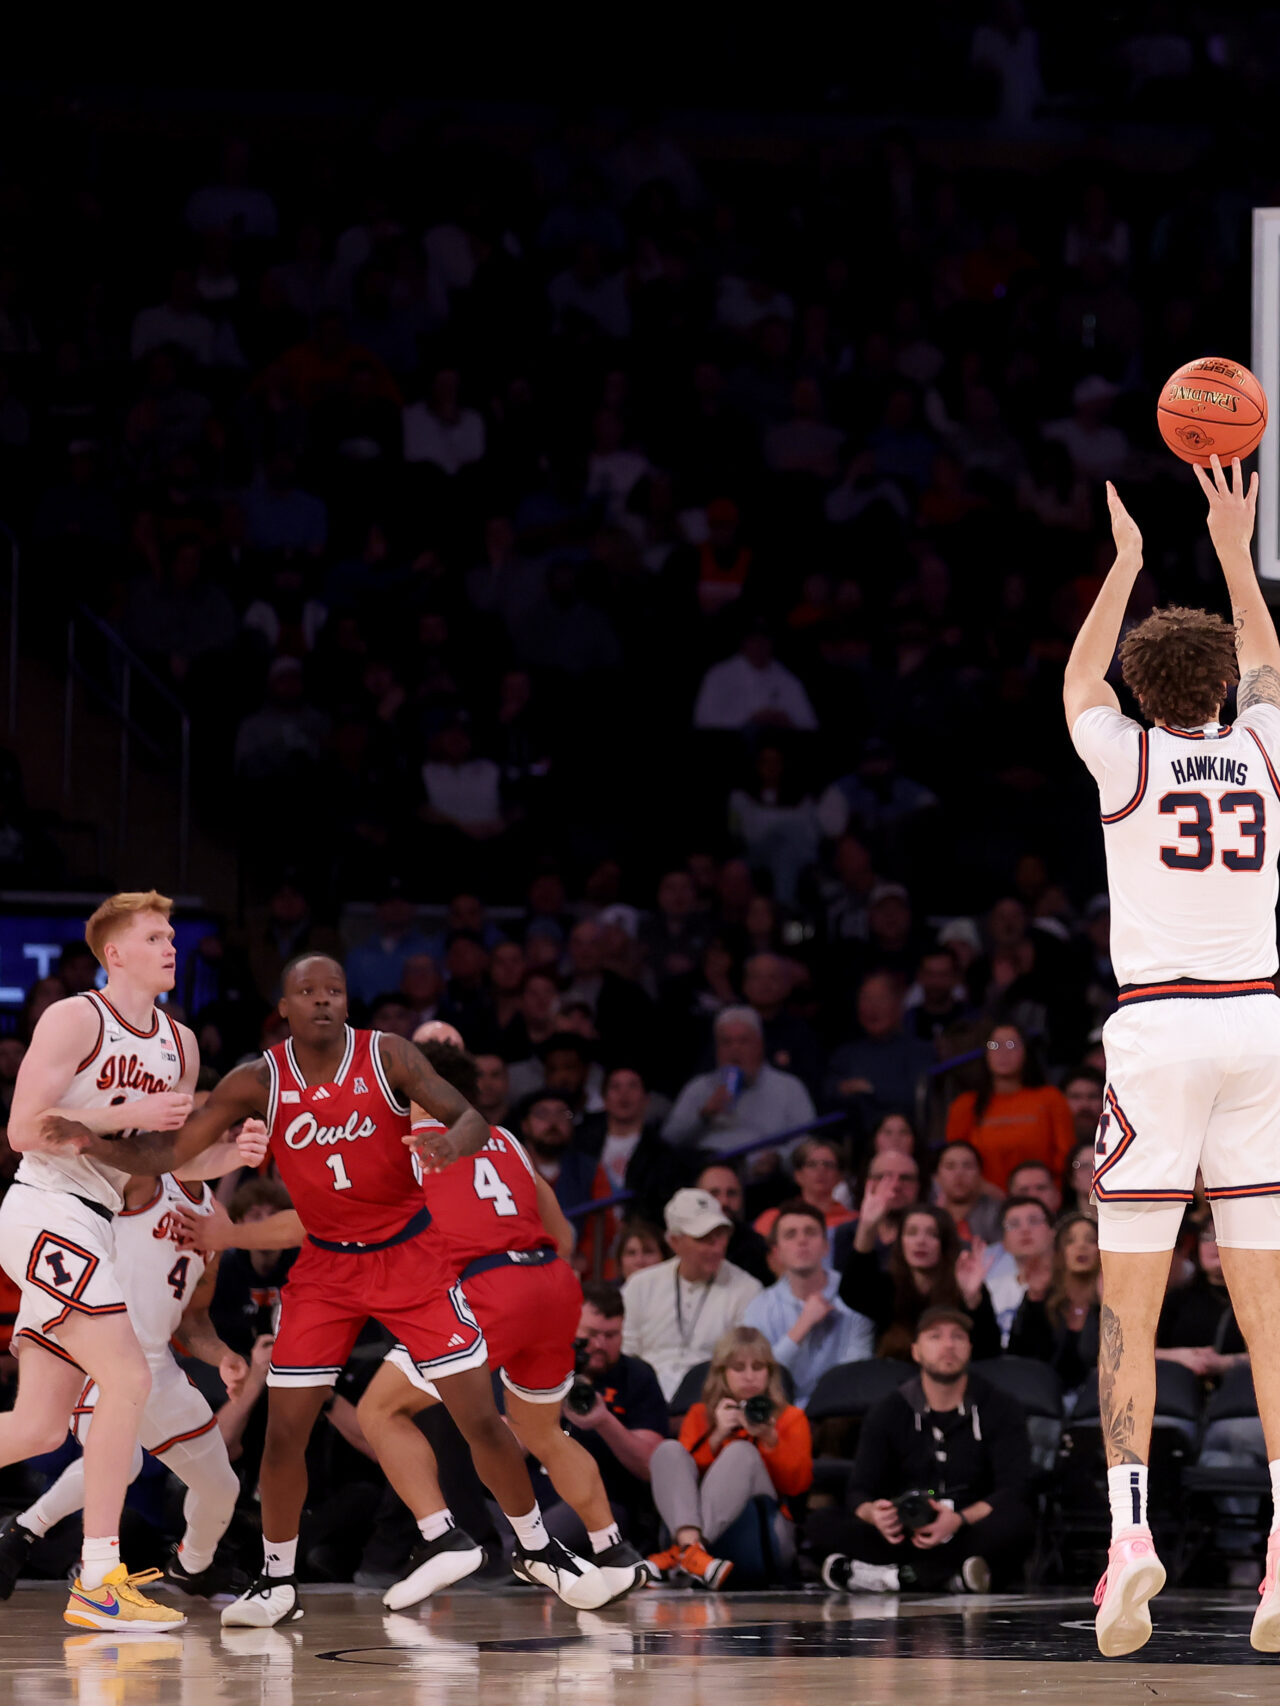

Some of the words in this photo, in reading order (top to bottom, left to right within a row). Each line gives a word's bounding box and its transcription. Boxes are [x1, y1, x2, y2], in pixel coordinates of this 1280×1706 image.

[1169, 384, 1241, 413] SPALDING
[1171, 756, 1248, 786] HAWKINS
[1158, 790, 1266, 872] 33
[96, 1054, 172, 1094] Illinoi
[284, 1110, 377, 1150] Owls
[325, 1153, 352, 1191] 1
[473, 1156, 519, 1217] 4
[167, 1255, 191, 1301] 4
